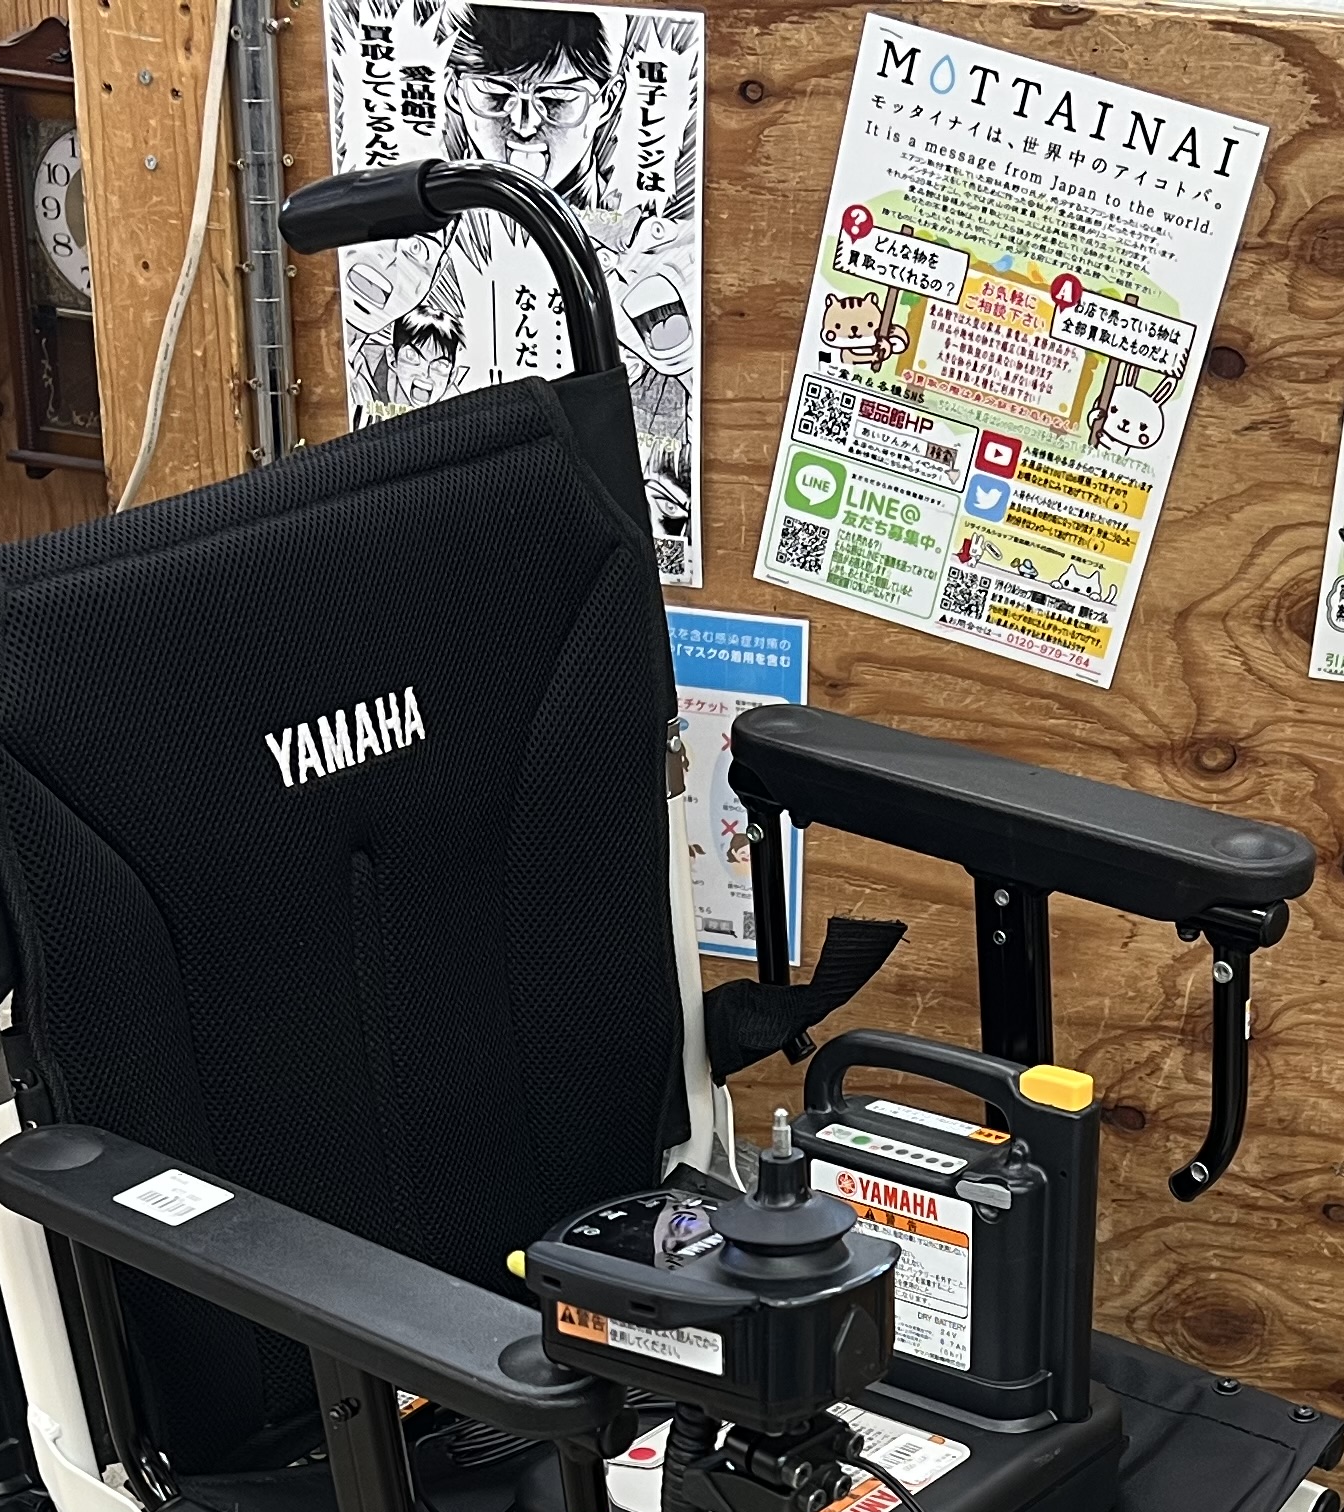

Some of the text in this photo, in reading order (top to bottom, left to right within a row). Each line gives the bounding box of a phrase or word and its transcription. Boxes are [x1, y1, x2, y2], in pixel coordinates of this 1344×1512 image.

[399, 65, 436, 137] 愛品館で
[635, 61, 668, 193] 電子レンジは
[868, 89, 1226, 211] モッタイナイは、世界中のアイコトバ。
[46, 163, 70, 187] 10
[863, 119, 1217, 236] It is a message from Japan to the world.
[41, 196, 61, 220] 9
[52, 233, 73, 257] 8
[873, 235, 940, 270] どんな物を
[964, 293, 1046, 332] ご相談下さい
[981, 279, 1038, 311] お気軽に
[1059, 316, 1180, 368] 全部買取したものだよ！
[801, 473, 830, 493] LINE
[845, 485, 922, 527] LINE@
[841, 508, 944, 554] 友だち募集中。
[264, 686, 426, 788] YAMAHA
[859, 1177, 938, 1222] YAMAHA
